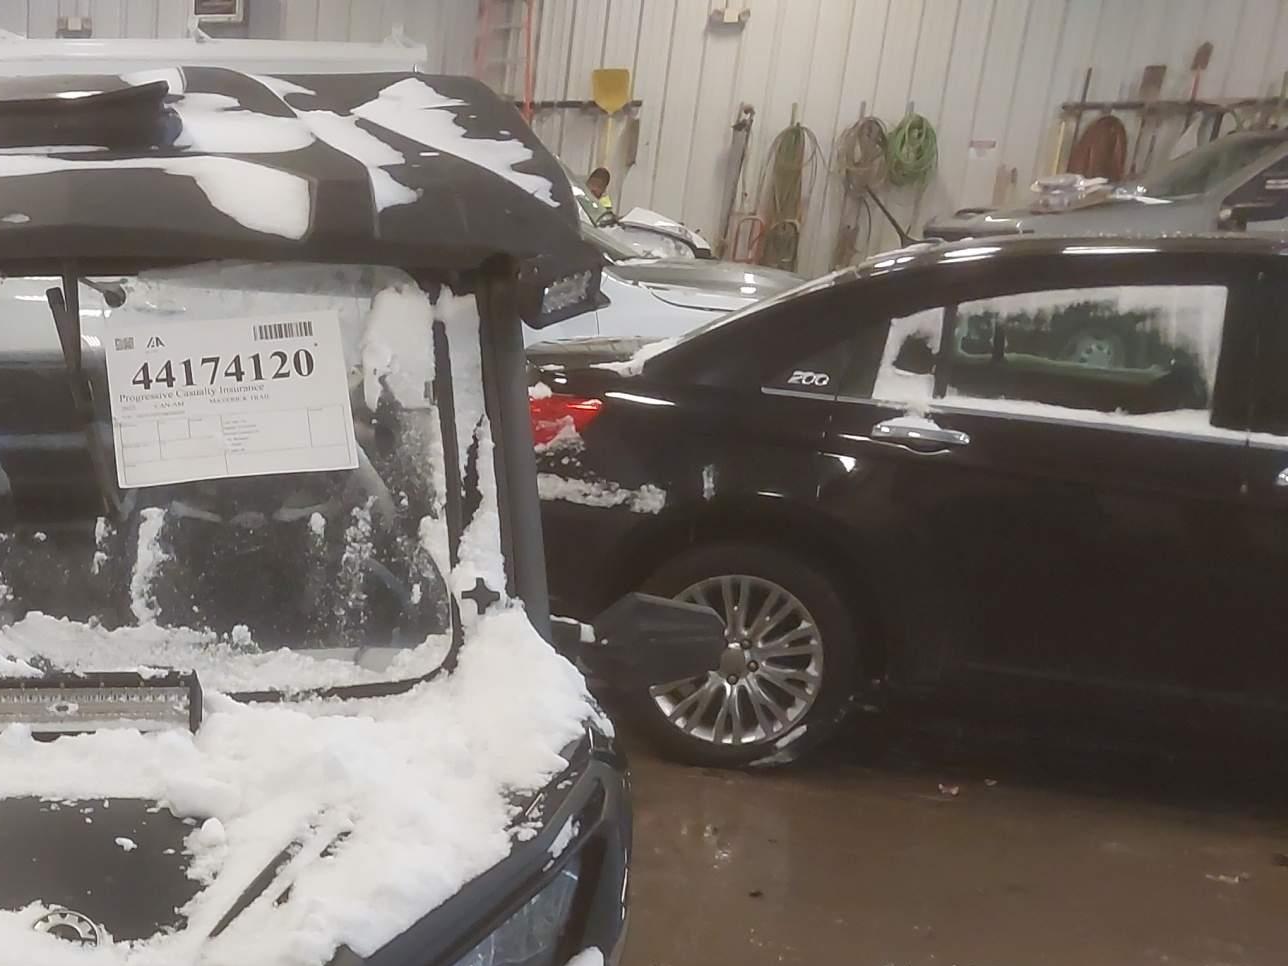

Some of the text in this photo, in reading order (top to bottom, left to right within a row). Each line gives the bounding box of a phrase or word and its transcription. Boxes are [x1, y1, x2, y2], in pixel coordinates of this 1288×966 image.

[132, 348, 314, 390] 44174120
[787, 370, 830, 386] 200
[119, 384, 265, 403] Progressive Casualty Insurance
